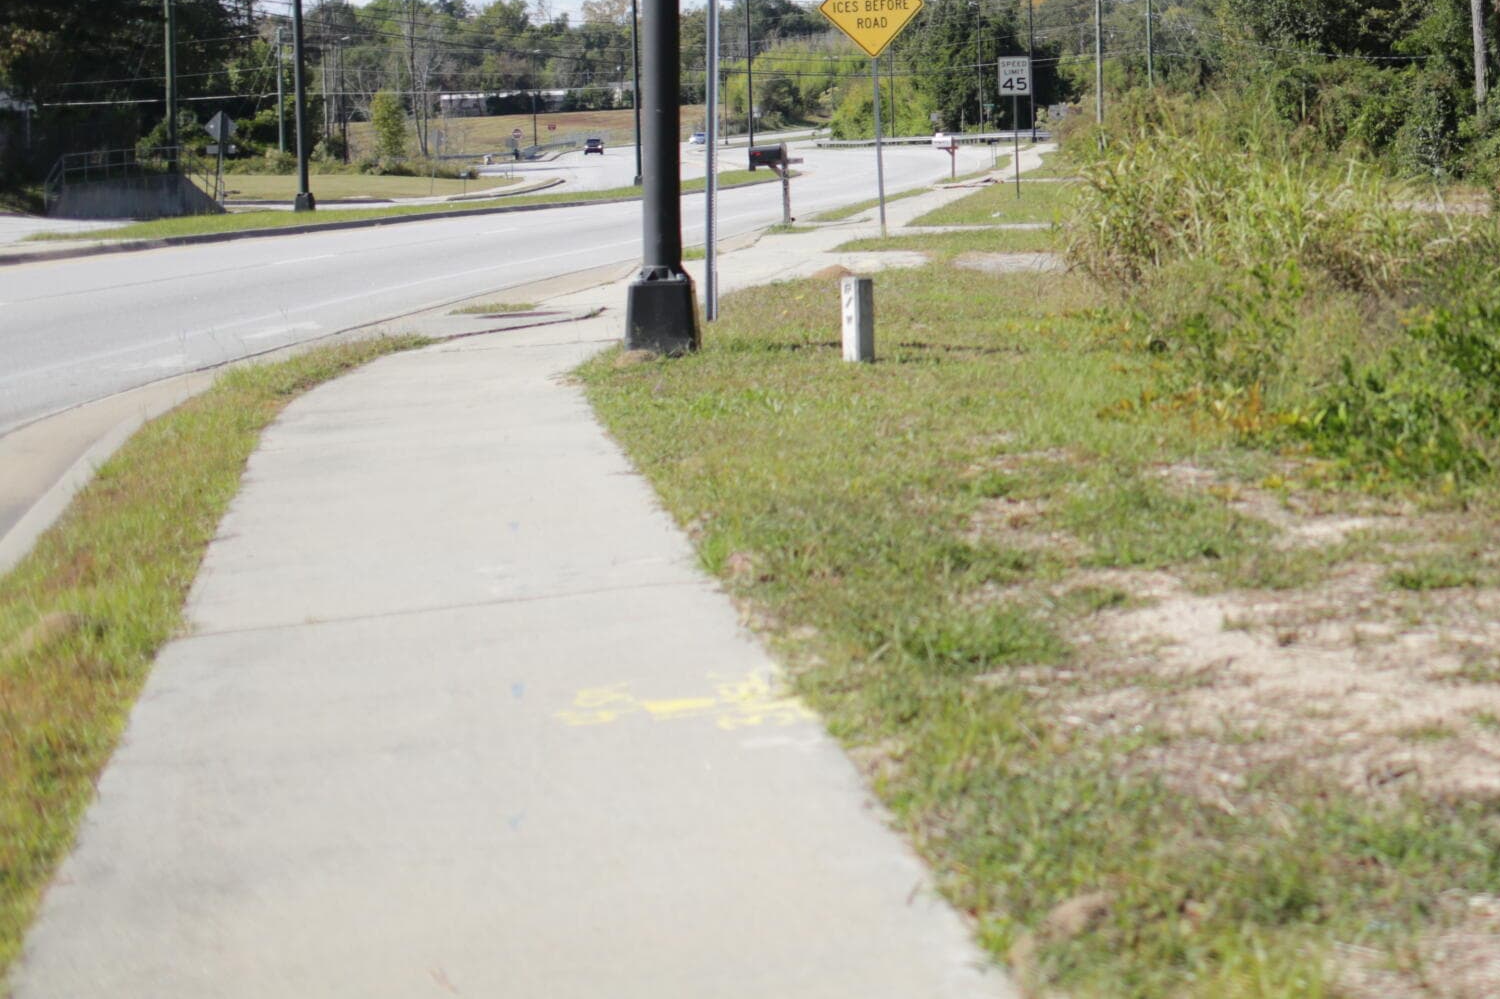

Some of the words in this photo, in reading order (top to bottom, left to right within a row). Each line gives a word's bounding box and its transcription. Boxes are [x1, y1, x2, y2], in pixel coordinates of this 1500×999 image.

[832, 1, 859, 14] ICES
[856, 17, 888, 29] ROAD
[1001, 60, 1027, 68] SPEED
[1002, 77, 1027, 91] 45
